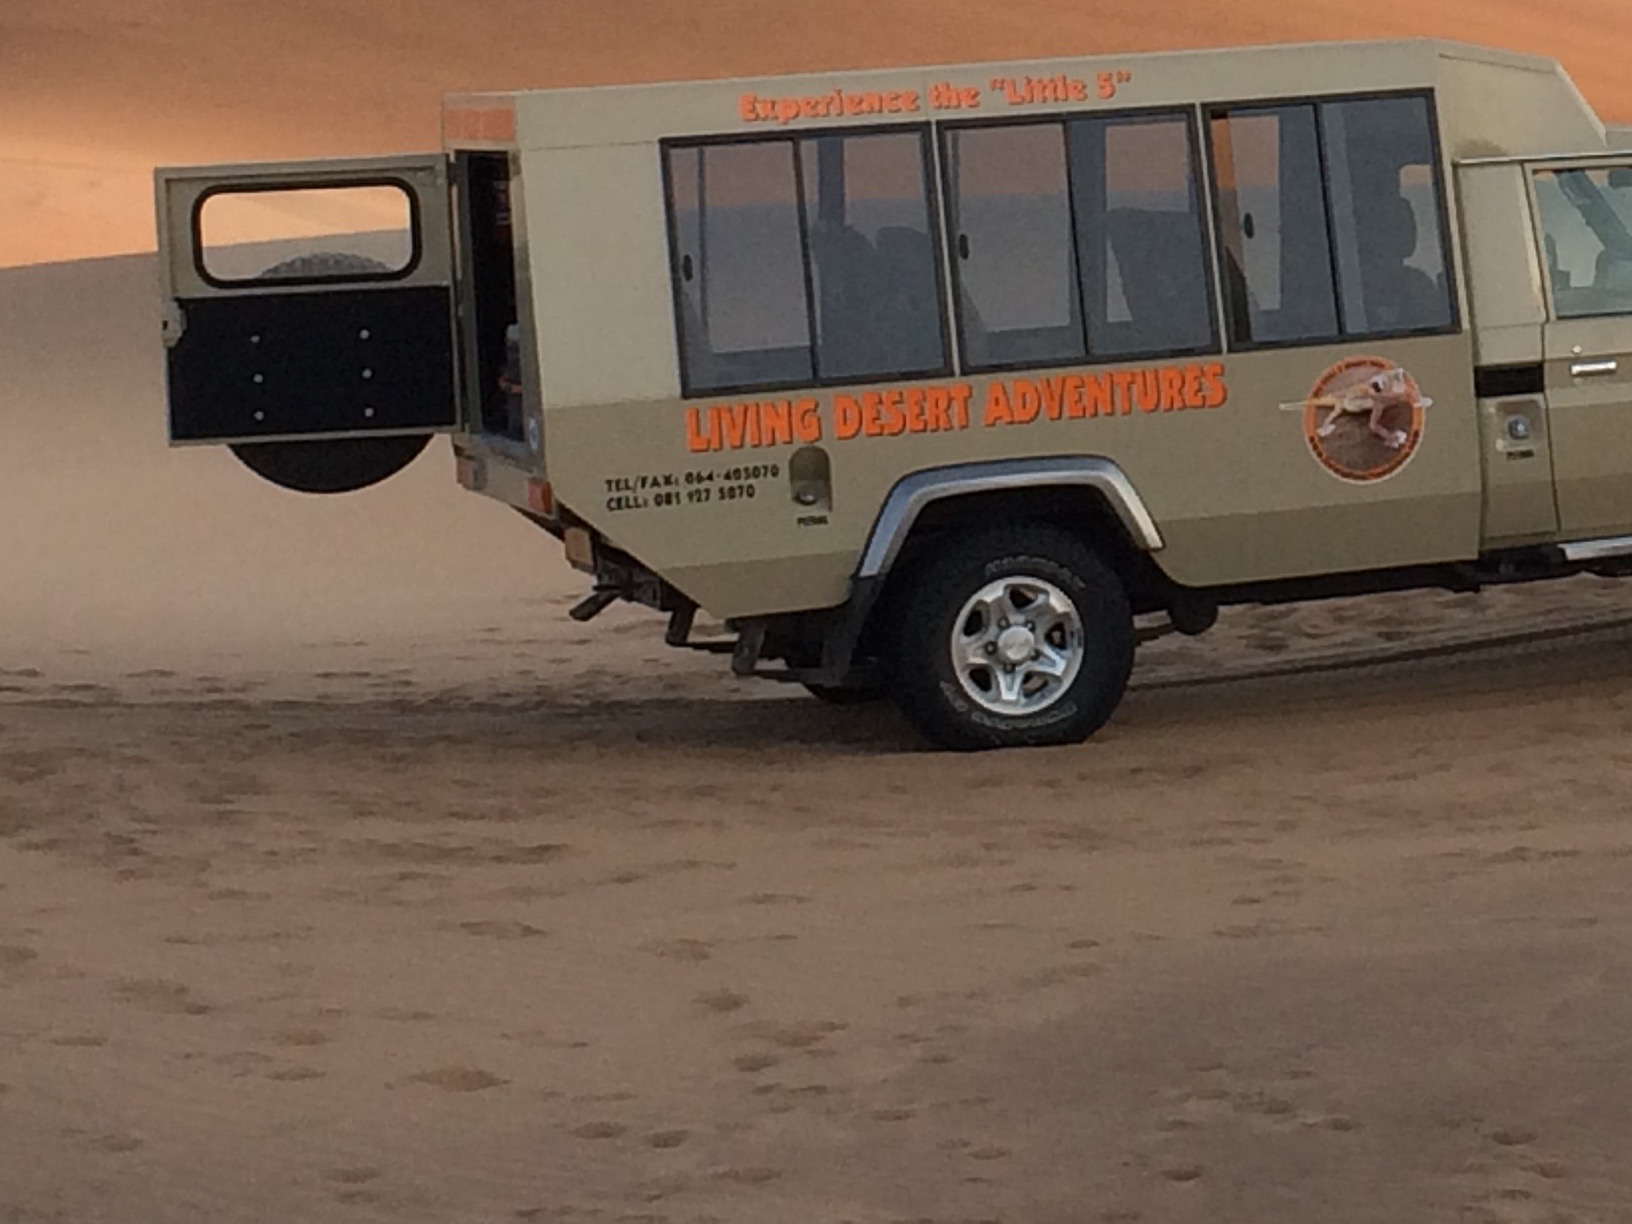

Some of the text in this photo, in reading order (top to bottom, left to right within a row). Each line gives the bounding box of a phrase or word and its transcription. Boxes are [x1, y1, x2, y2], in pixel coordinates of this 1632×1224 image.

[738, 87, 922, 124] Experience
[928, 80, 981, 111] the
[684, 362, 1228, 453] LIVING DESERT ADVENTURES
[605, 464, 779, 492] TEL/FAX: 064-405070
[606, 493, 649, 512] CELL:
